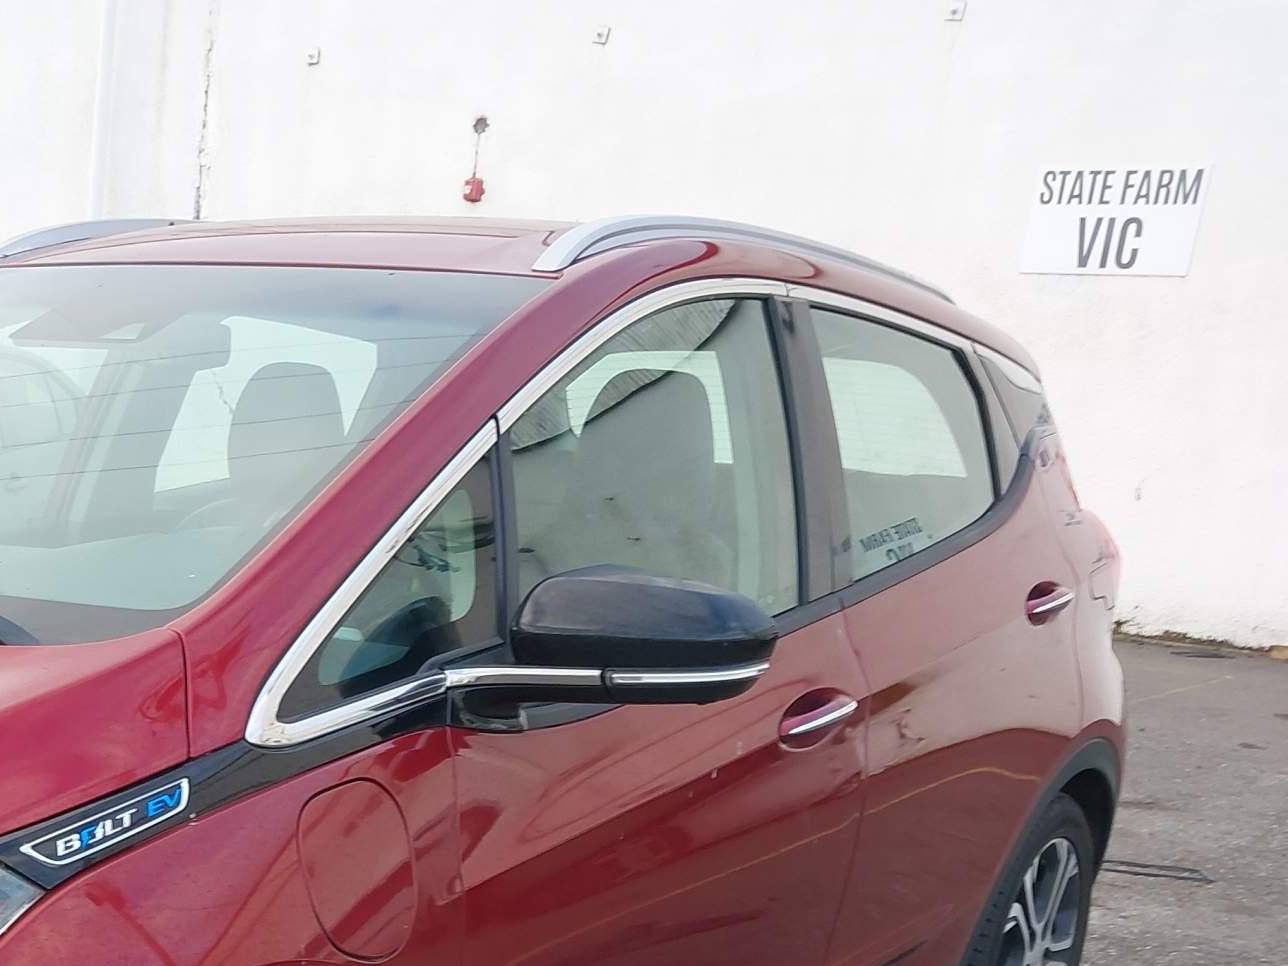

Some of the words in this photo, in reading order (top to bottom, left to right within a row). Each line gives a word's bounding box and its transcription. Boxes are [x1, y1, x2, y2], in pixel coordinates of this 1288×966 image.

[1040, 169, 1116, 205] STATE
[1120, 168, 1205, 205] FARM
[1076, 216, 1143, 270] VIC
[55, 808, 138, 857] BOLT
[145, 786, 182, 818] EV
